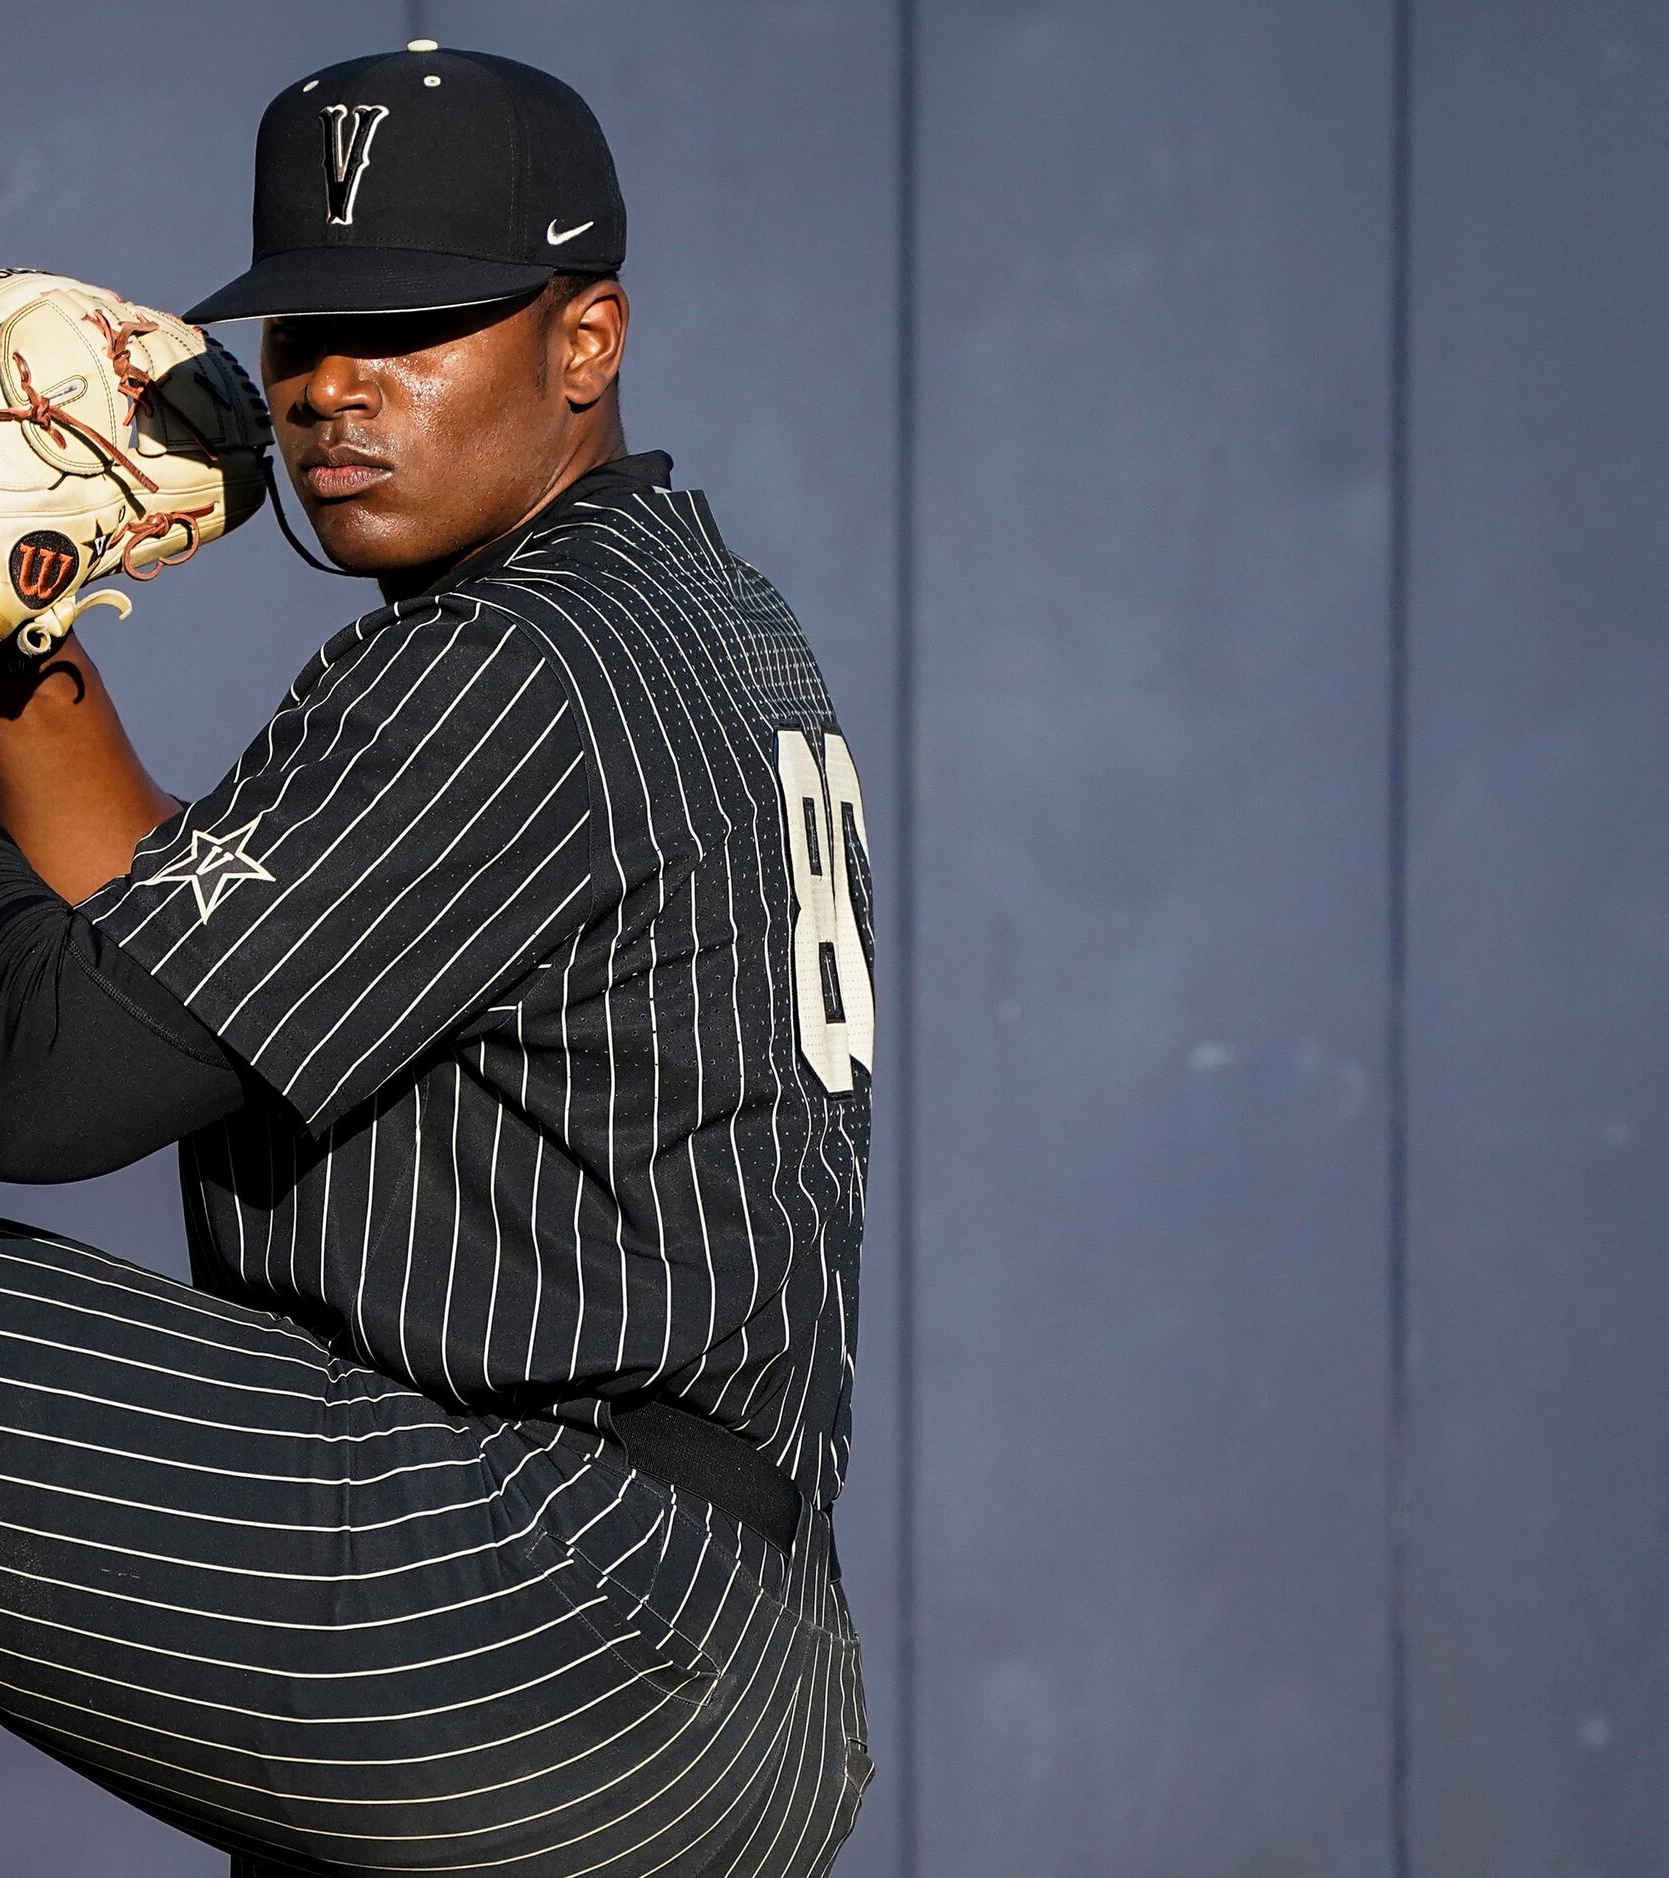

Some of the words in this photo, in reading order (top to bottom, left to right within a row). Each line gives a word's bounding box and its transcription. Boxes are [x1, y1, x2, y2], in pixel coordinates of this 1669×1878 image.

[318, 104, 389, 225] V
[19, 543, 73, 599] W
[195, 845, 235, 876] V
